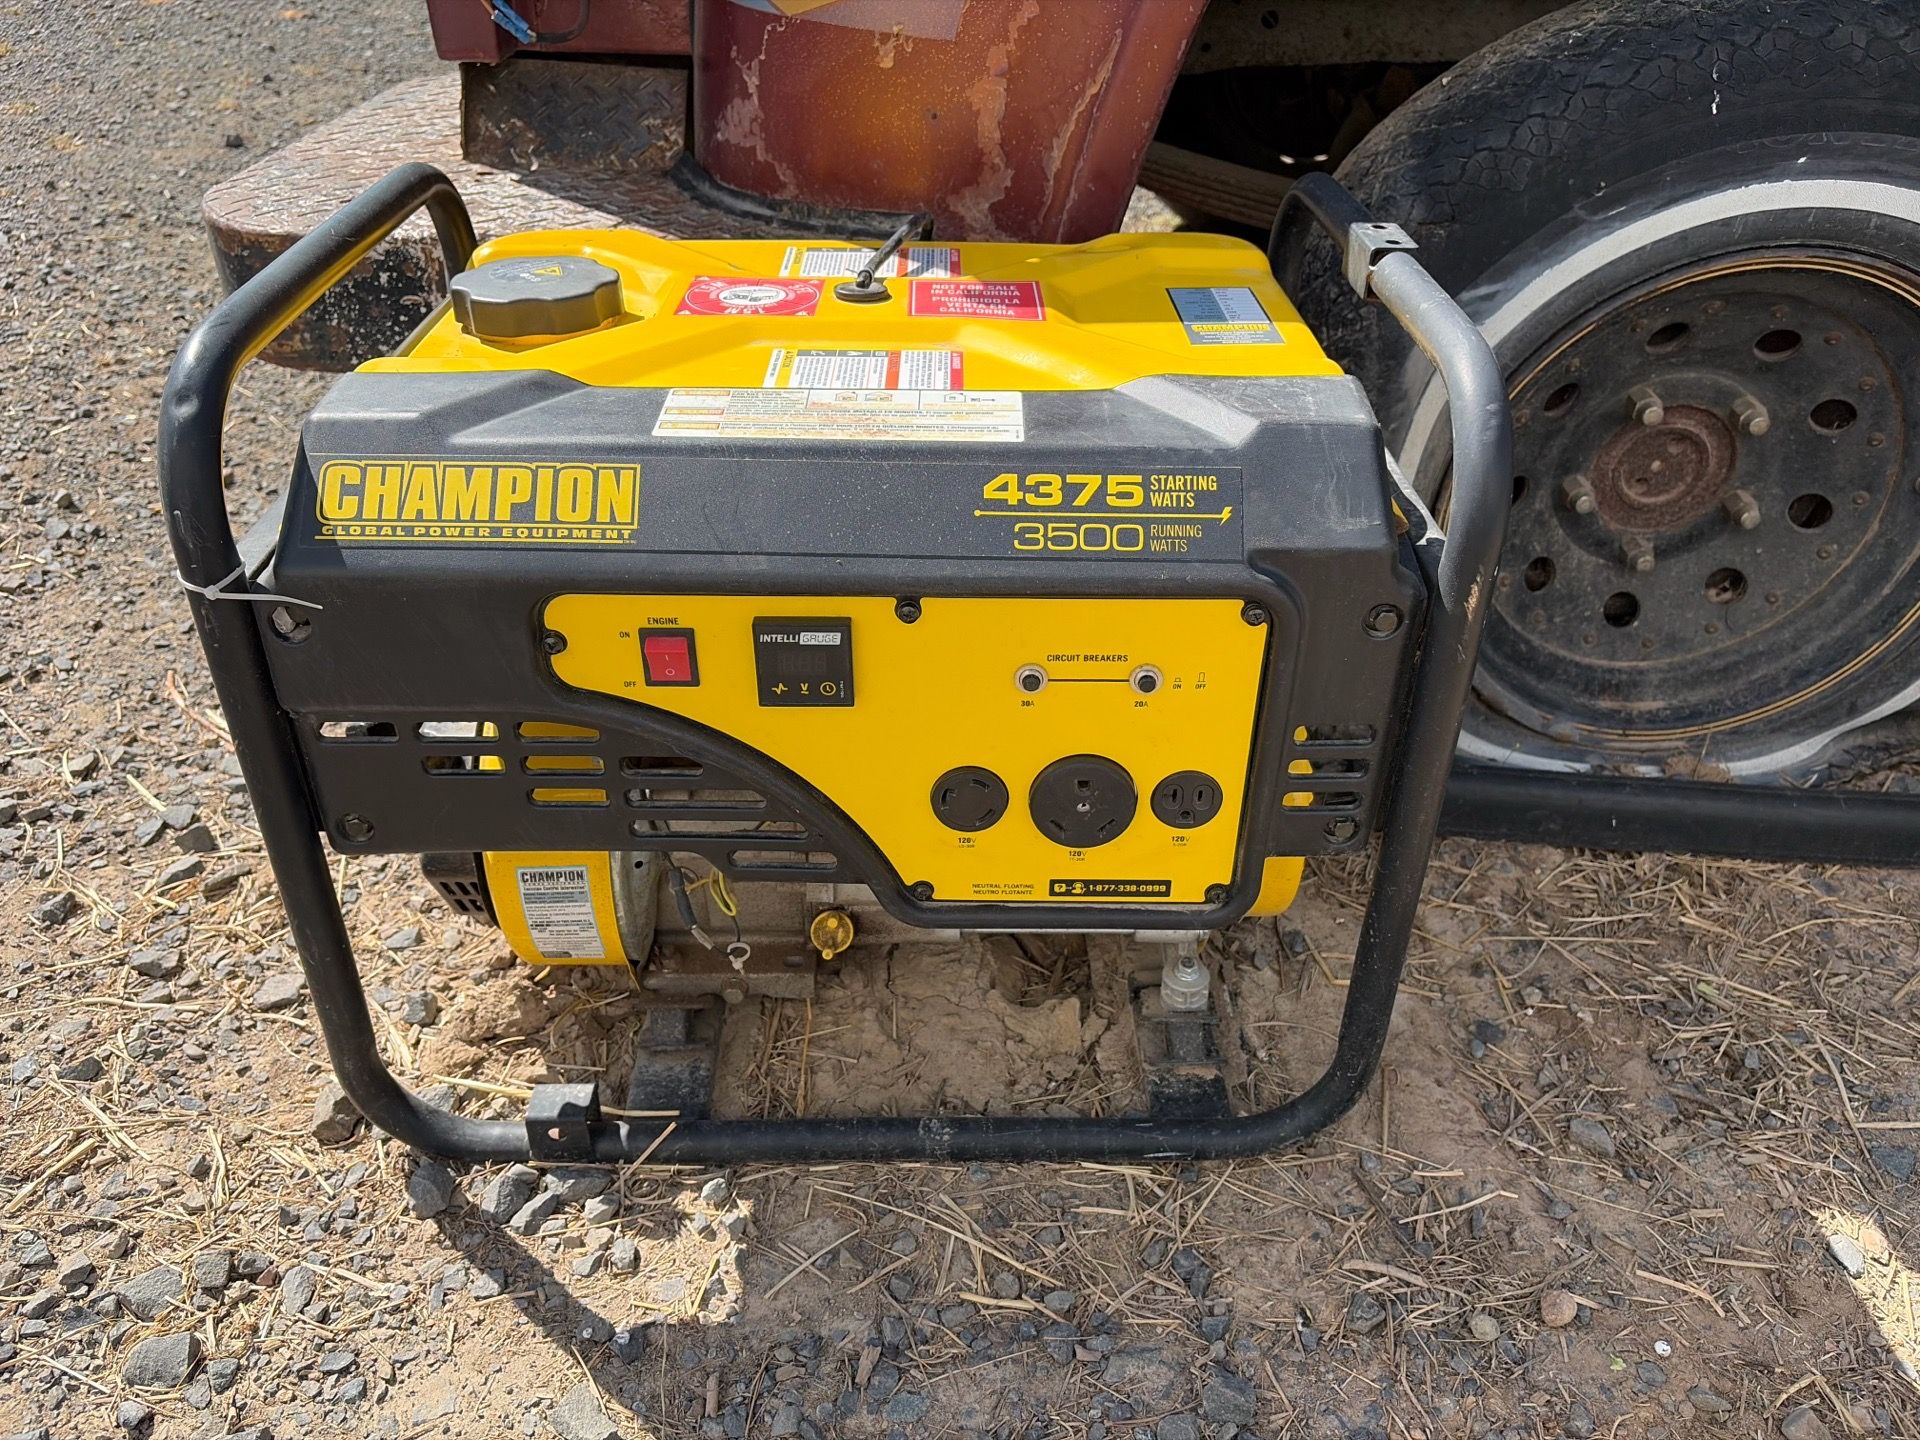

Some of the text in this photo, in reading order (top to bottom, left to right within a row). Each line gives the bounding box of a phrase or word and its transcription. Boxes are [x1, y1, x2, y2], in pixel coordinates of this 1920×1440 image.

[939, 308, 1015, 316] CALIFORNIA
[983, 473, 1144, 506] 4375
[1150, 475, 1217, 491] STARTING
[322, 464, 633, 523] CHAMPION
[1150, 492, 1195, 508] WATTS
[321, 525, 632, 539] GLOBAL POWER EQUIPMENT
[1013, 522, 1144, 551] 3500
[1150, 525, 1202, 538] RUNNING
[1150, 540, 1188, 552] WATTS
[647, 617, 679, 625] ENGINE
[1046, 654, 1129, 663] CIRCUIT BREAKERS
[521, 870, 584, 882] CHAMPION
[1089, 884, 1167, 892] 1-877-338-0999
